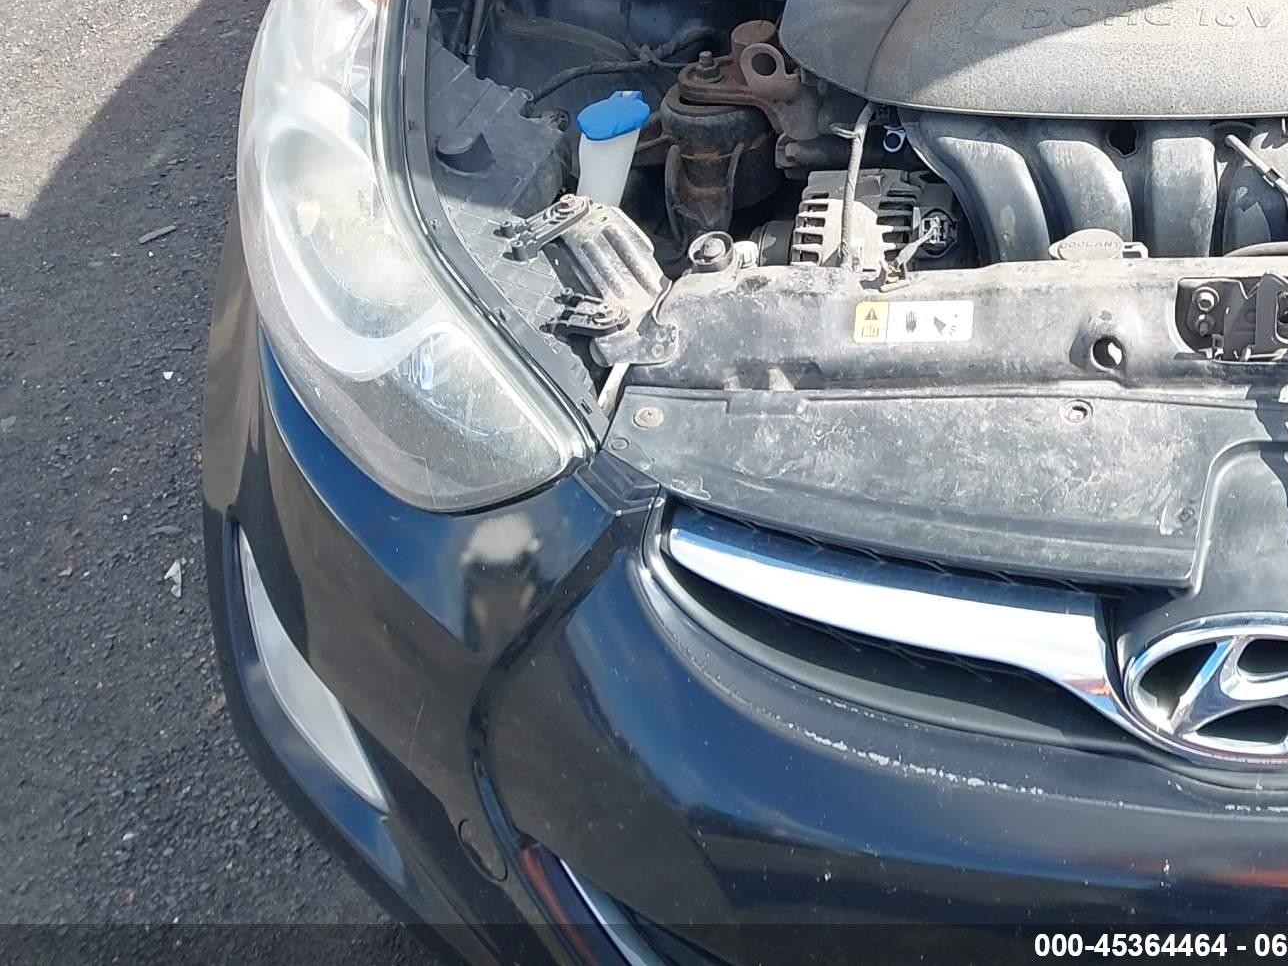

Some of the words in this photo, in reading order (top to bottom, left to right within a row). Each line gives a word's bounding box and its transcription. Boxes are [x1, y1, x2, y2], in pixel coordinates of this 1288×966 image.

[1021, 6, 1175, 30] DOHC
[1199, 5, 1273, 28] 16V
[1059, 240, 1121, 250] COOLANT
